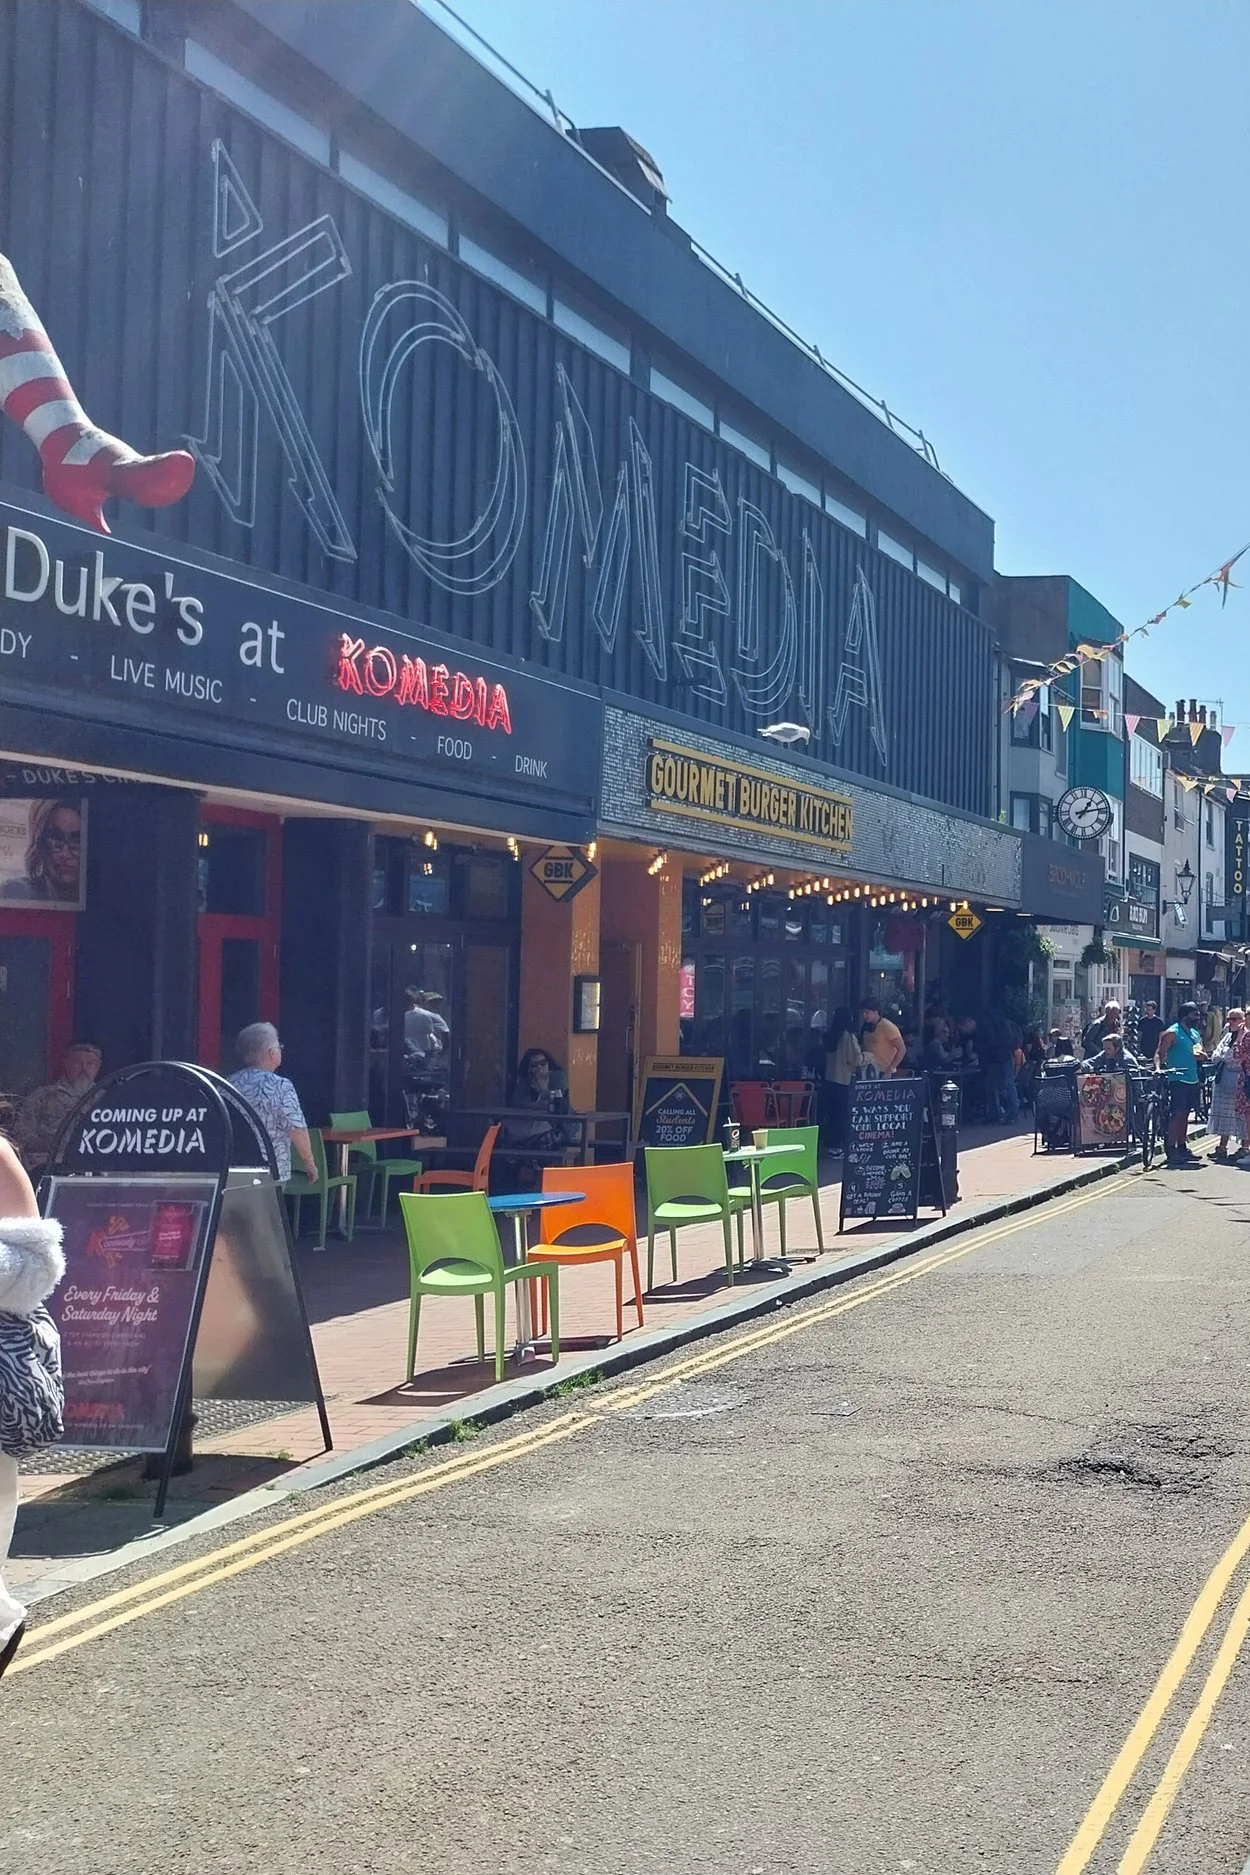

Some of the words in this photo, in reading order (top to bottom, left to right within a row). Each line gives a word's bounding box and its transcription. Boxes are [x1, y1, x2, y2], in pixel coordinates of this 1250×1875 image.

[181, 137, 888, 766] KOMEDIA
[5, 525, 204, 646] Duke's
[239, 620, 286, 674] at
[337, 631, 512, 735] KOMEDIA
[110, 654, 155, 688] LIVE
[165, 667, 223, 704] MUSIC
[286, 698, 328, 727] CLUB
[333, 709, 387, 741] NIGHTS
[437, 735, 473, 760] FOOD
[515, 754, 549, 779] DRINK
[651, 754, 737, 812] GOURMET
[739, 779, 798, 826] BURGER
[799, 795, 853, 841] KITCHEN
[1233, 820, 1244, 894] TATTOO
[543, 862, 574, 879] GBK
[955, 917, 974, 928] GBK
[856, 1088, 916, 1102] KOMEDIA
[91, 1108, 157, 1123] COMING
[161, 1108, 183, 1122] UP
[185, 1108, 207, 1122] AT
[656, 1115, 696, 1125] Students
[851, 1107, 859, 1115] 5
[863, 1105, 889, 1114] WAYS
[894, 1104, 911, 1113] YOU
[852, 1115, 871, 1124] CAN
[874, 1112, 914, 1123] SUPPORT
[655, 1125, 673, 1134] 20%
[675, 1126, 694, 1134] OFF
[851, 1123, 872, 1132] YOUR
[877, 1121, 907, 1131] LOCAL
[78, 1127, 206, 1155] KOMEDIA
[660, 1133, 687, 1142] FOOD
[64, 1285, 102, 1305] Every
[102, 1285, 147, 1306] Friday
[146, 1286, 160, 1303] &
[61, 1305, 121, 1325] Saturday
[121, 1306, 158, 1326] Night
